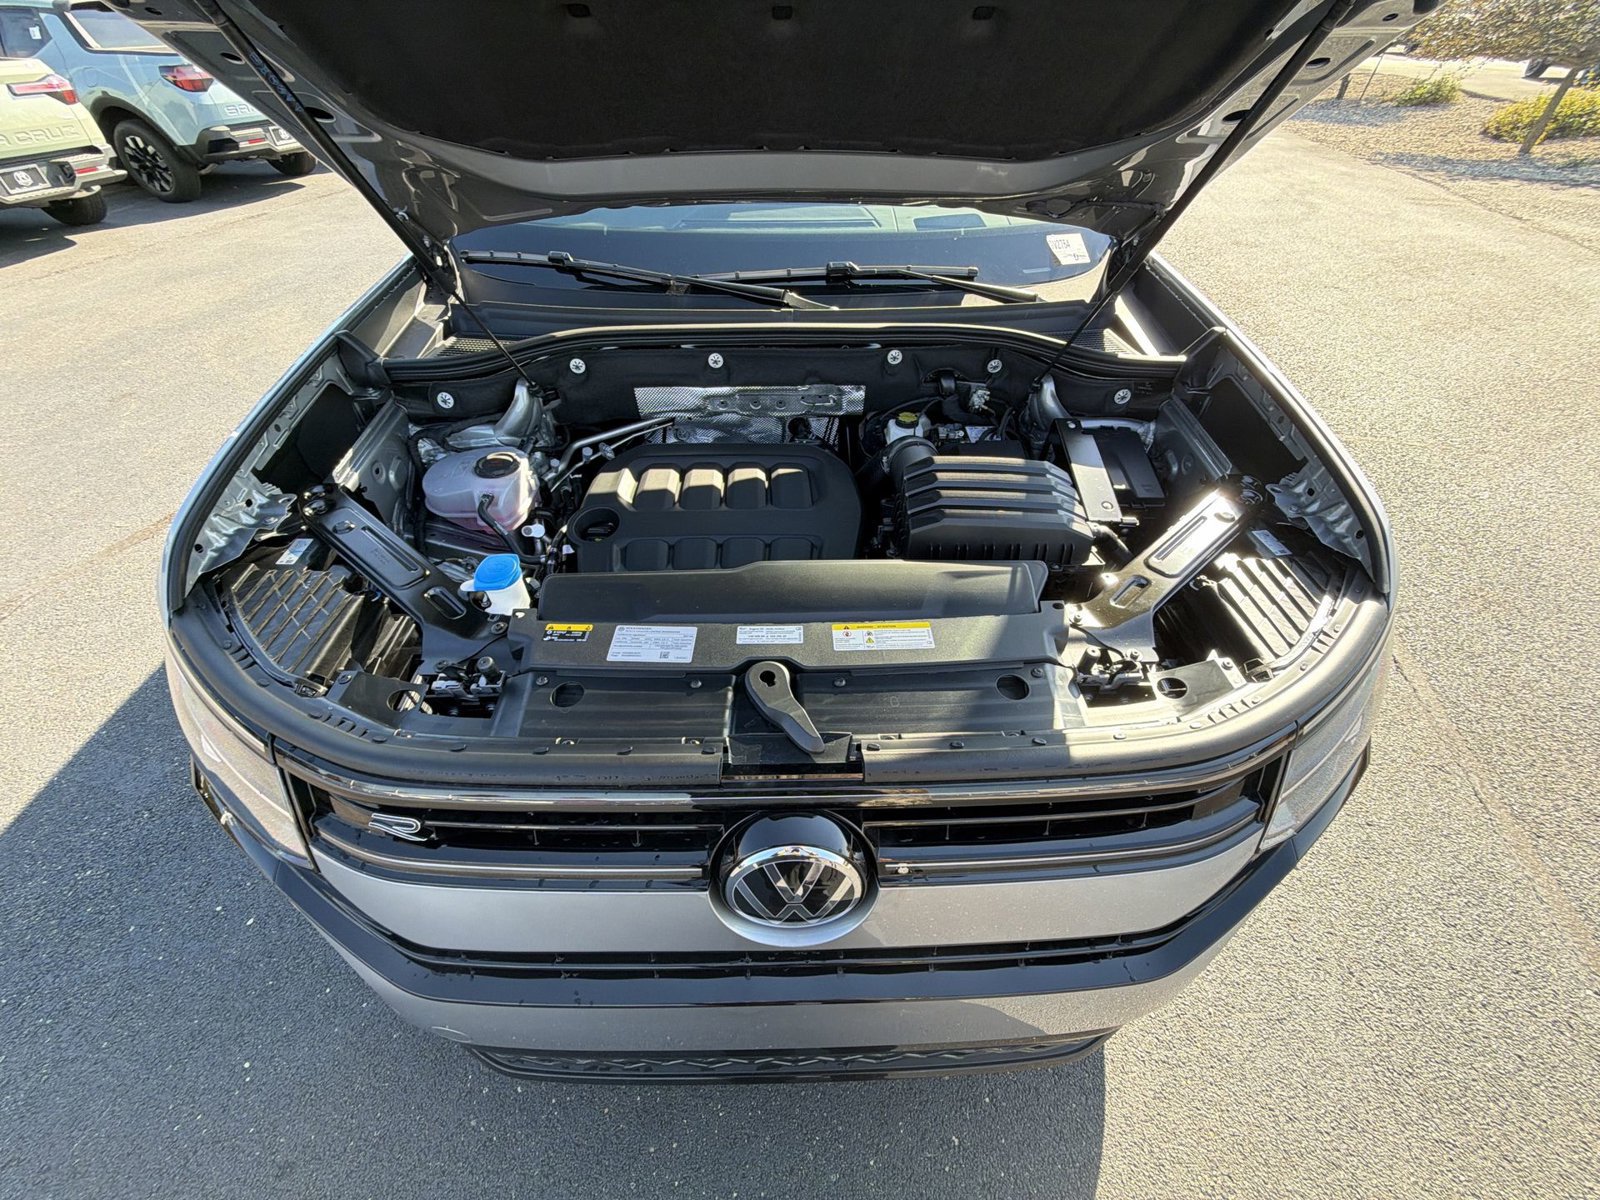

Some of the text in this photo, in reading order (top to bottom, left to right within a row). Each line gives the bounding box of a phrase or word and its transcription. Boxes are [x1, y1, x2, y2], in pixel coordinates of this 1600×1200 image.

[15, 124, 80, 145] CRUZ
[368, 812, 428, 842] R
[732, 859, 855, 926] VW
